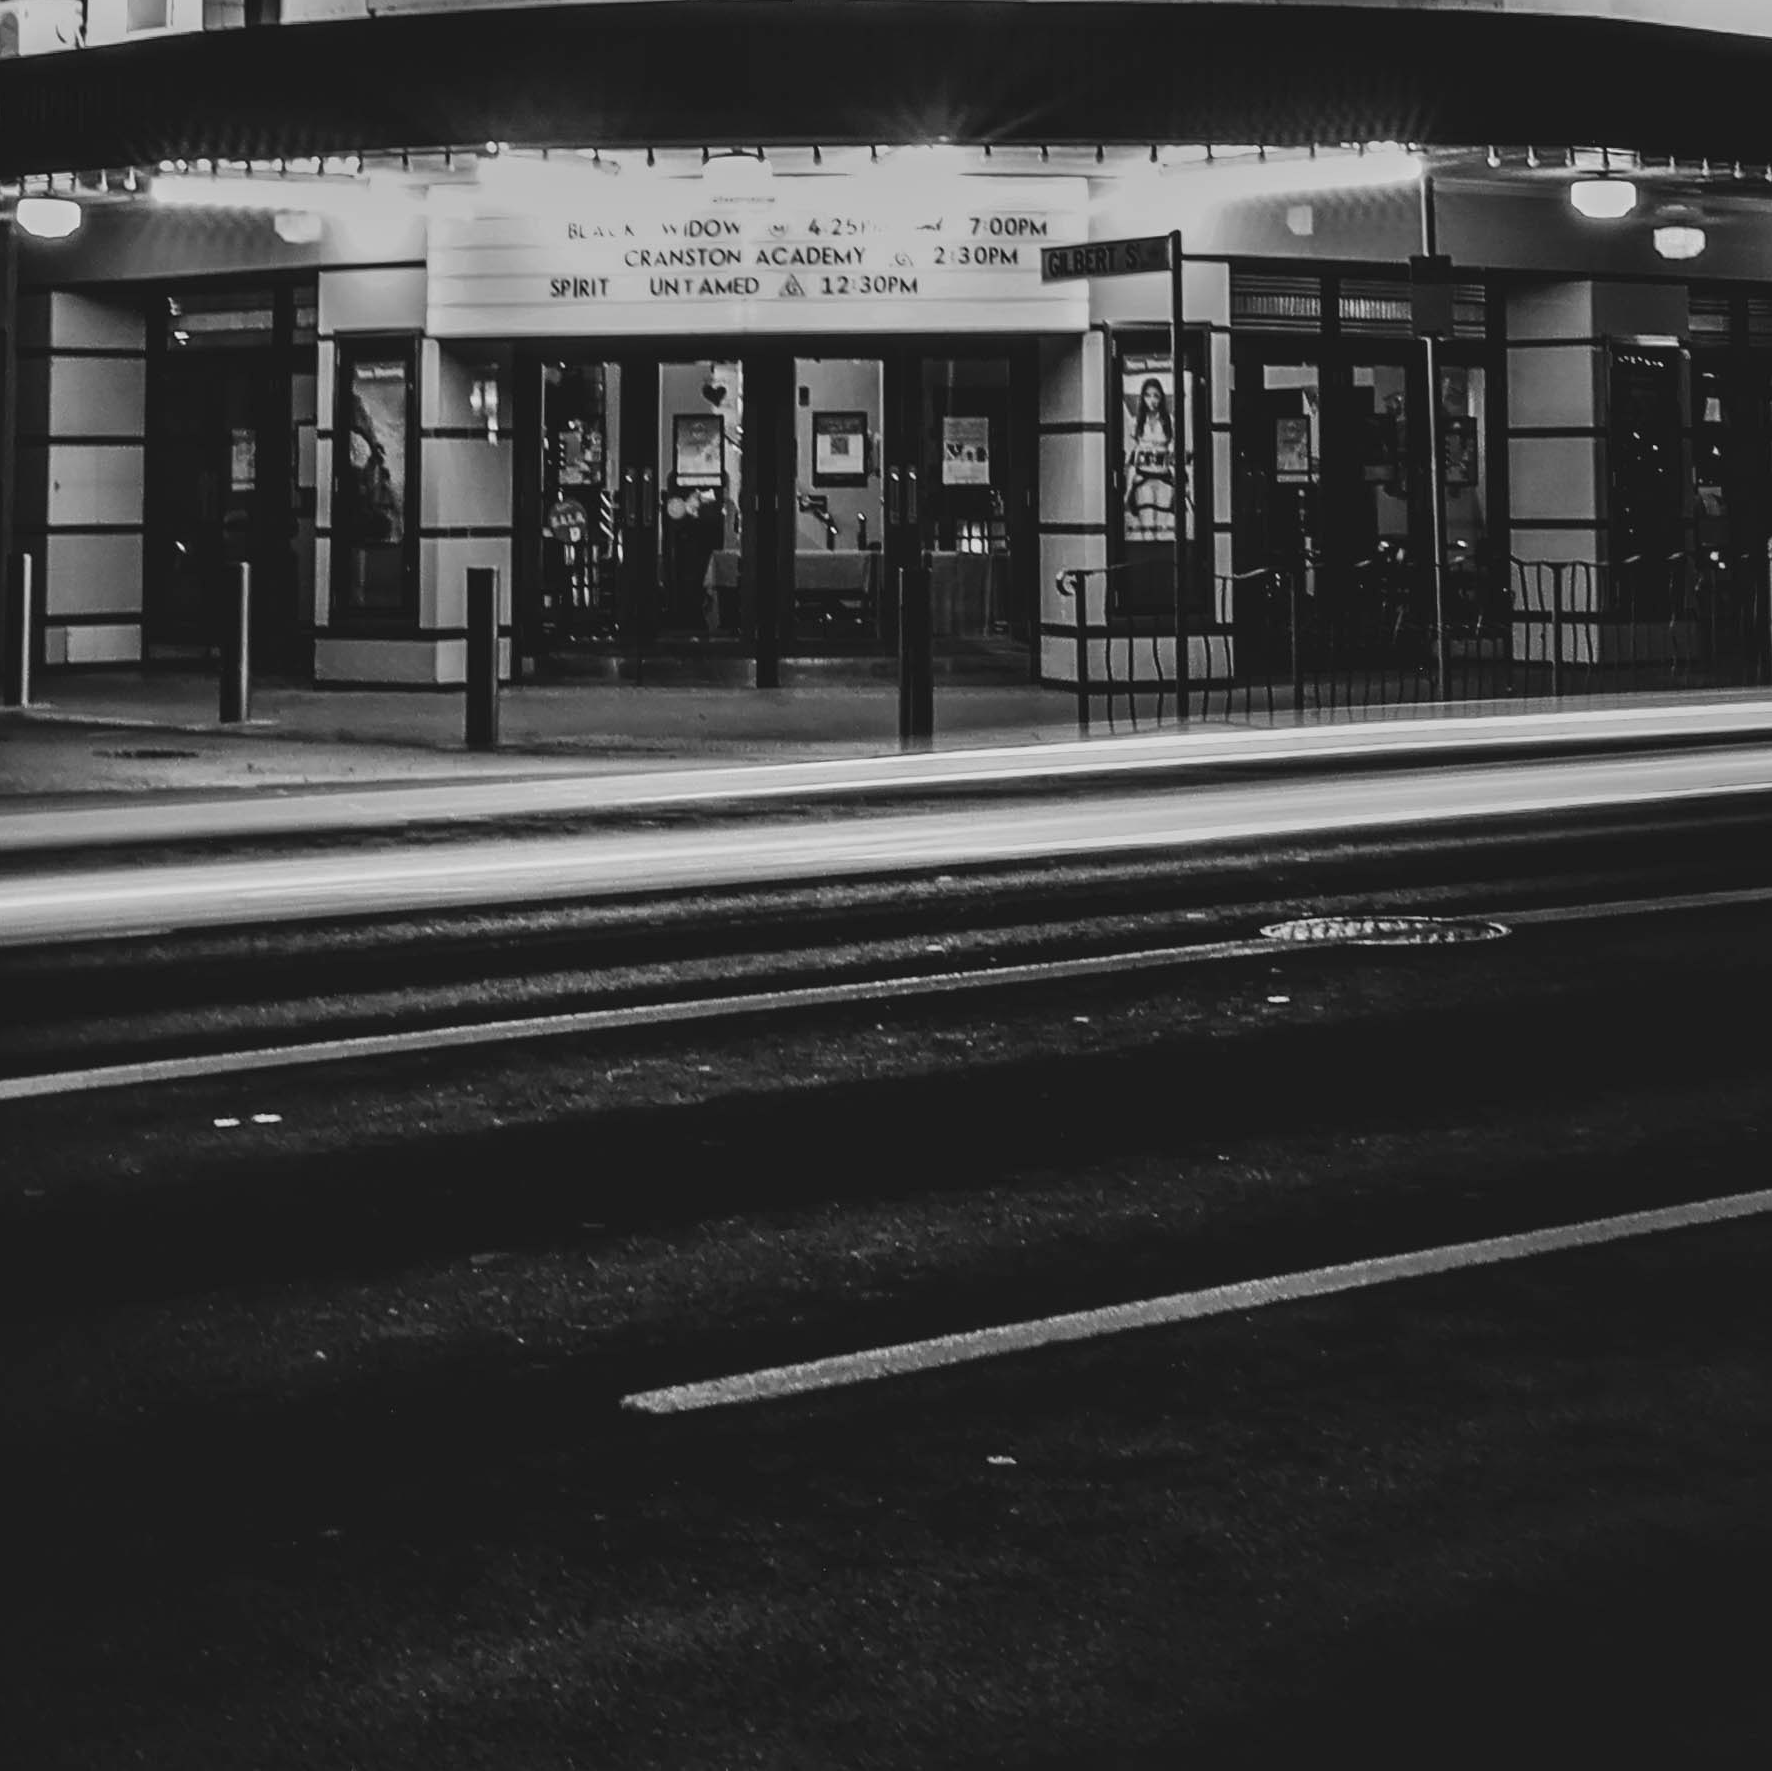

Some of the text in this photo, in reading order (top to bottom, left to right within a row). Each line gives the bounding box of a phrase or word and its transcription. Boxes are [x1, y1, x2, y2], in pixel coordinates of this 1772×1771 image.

[968, 217, 1048, 236] 7:00PM
[624, 247, 742, 267] CRANSTON
[756, 246, 866, 266] ACADEMY
[933, 246, 1019, 265] 2:30PM
[1048, 245, 1117, 278] GILBERT
[549, 276, 610, 298] SPIRIT
[649, 276, 760, 297] UNTAMED
[821, 275, 919, 295] 12:30PM
